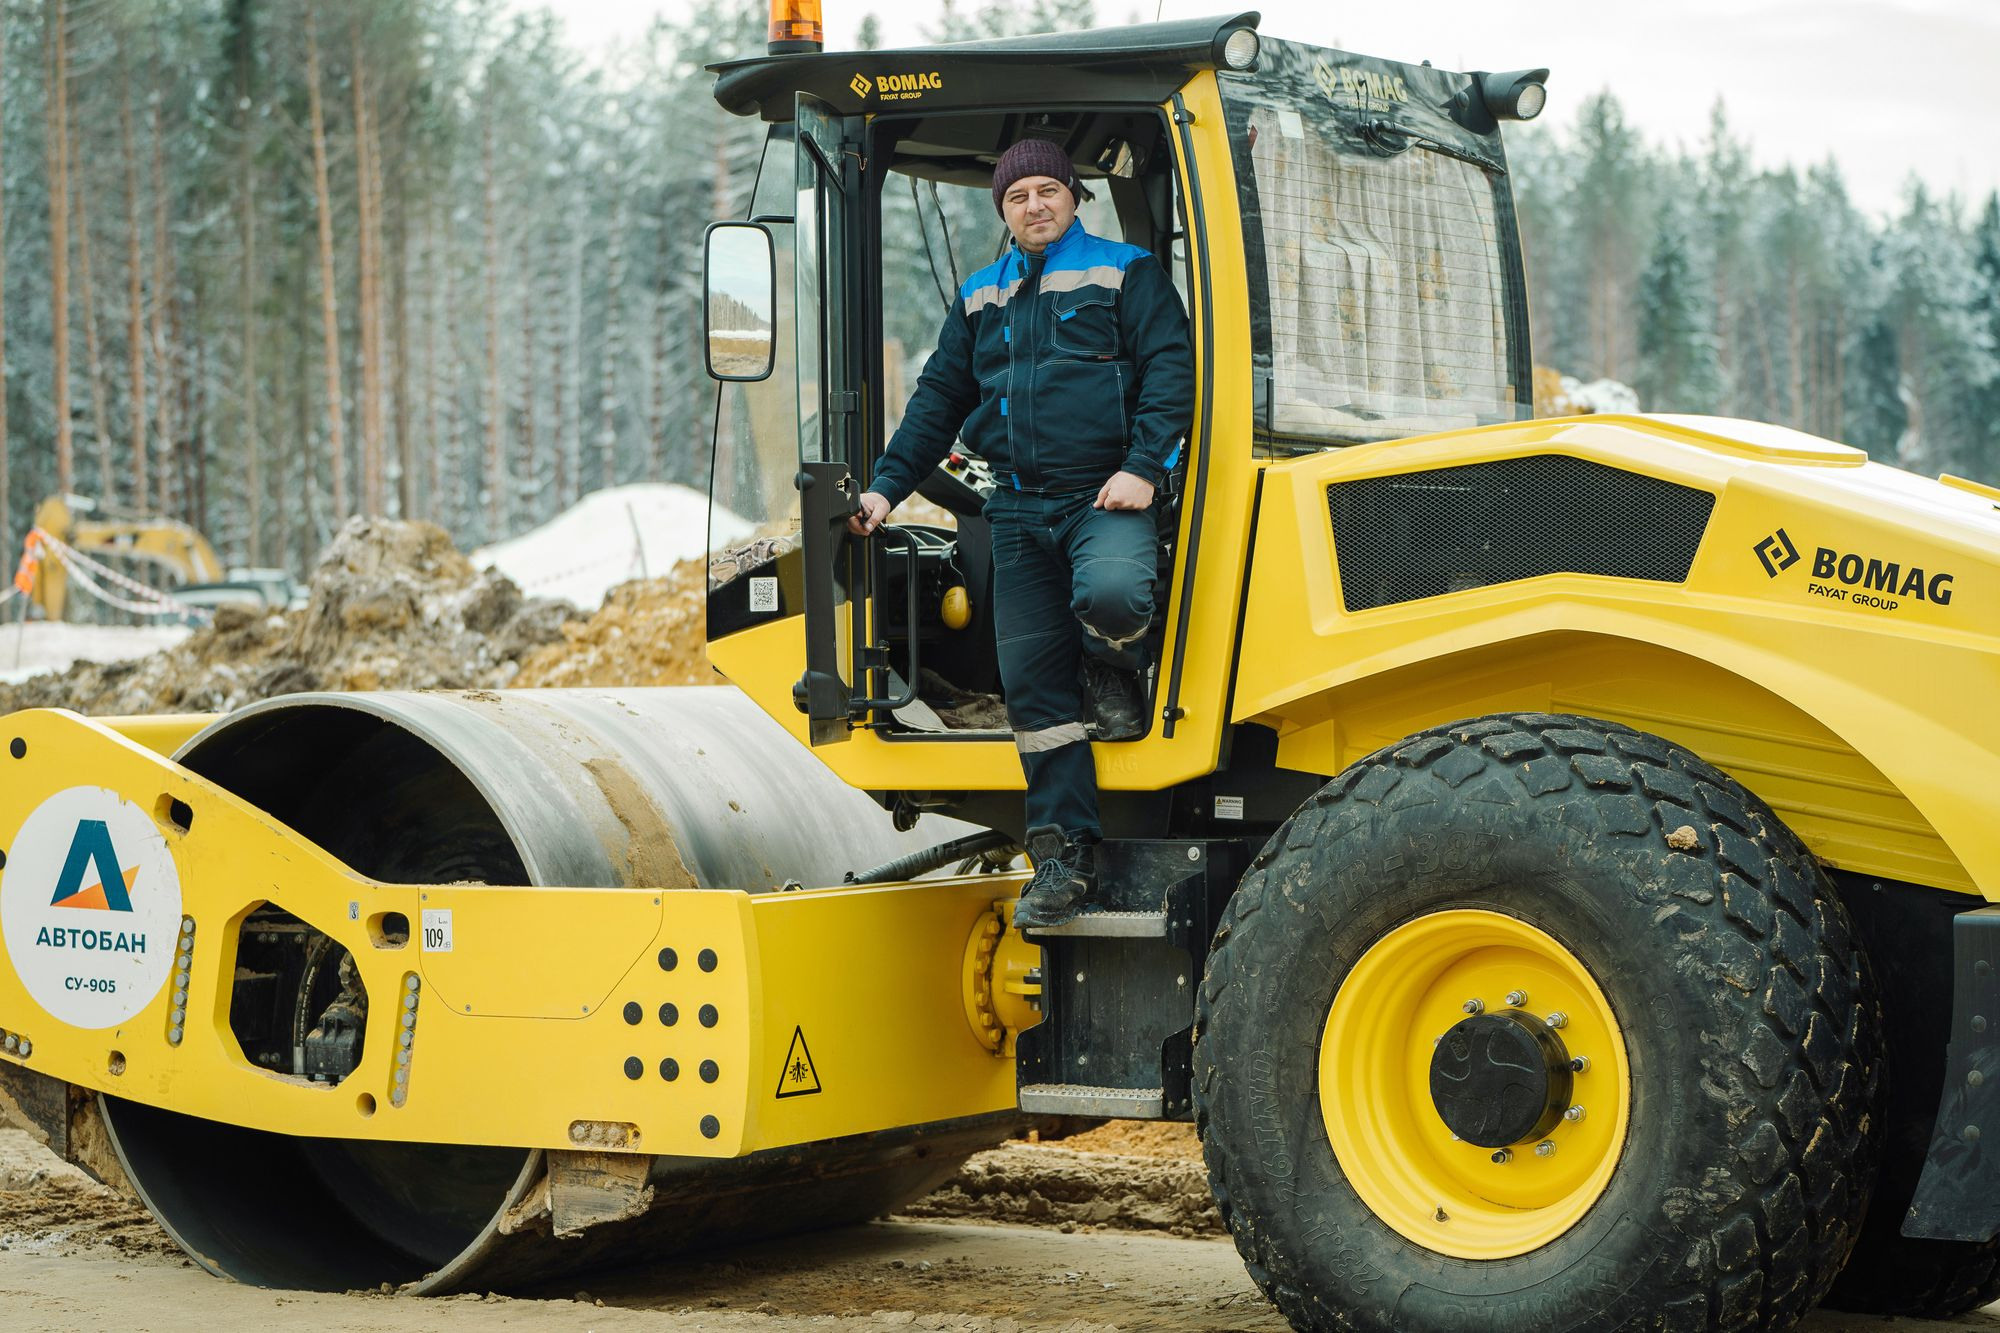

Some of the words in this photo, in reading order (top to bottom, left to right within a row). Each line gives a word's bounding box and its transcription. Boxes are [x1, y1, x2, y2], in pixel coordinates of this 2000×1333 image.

[876, 72, 942, 92] BOMAG
[1340, 67, 1408, 102] BOMAG
[900, 92, 921, 100] GROUP
[1812, 547, 1954, 606] BOMAG
[1808, 583, 1848, 601] FAYAT
[1852, 593, 1898, 611] GROUP
[36, 926, 146, 954] АВТОБАН
[425, 928, 443, 948] 109
[65, 976, 116, 993] СУ-905
